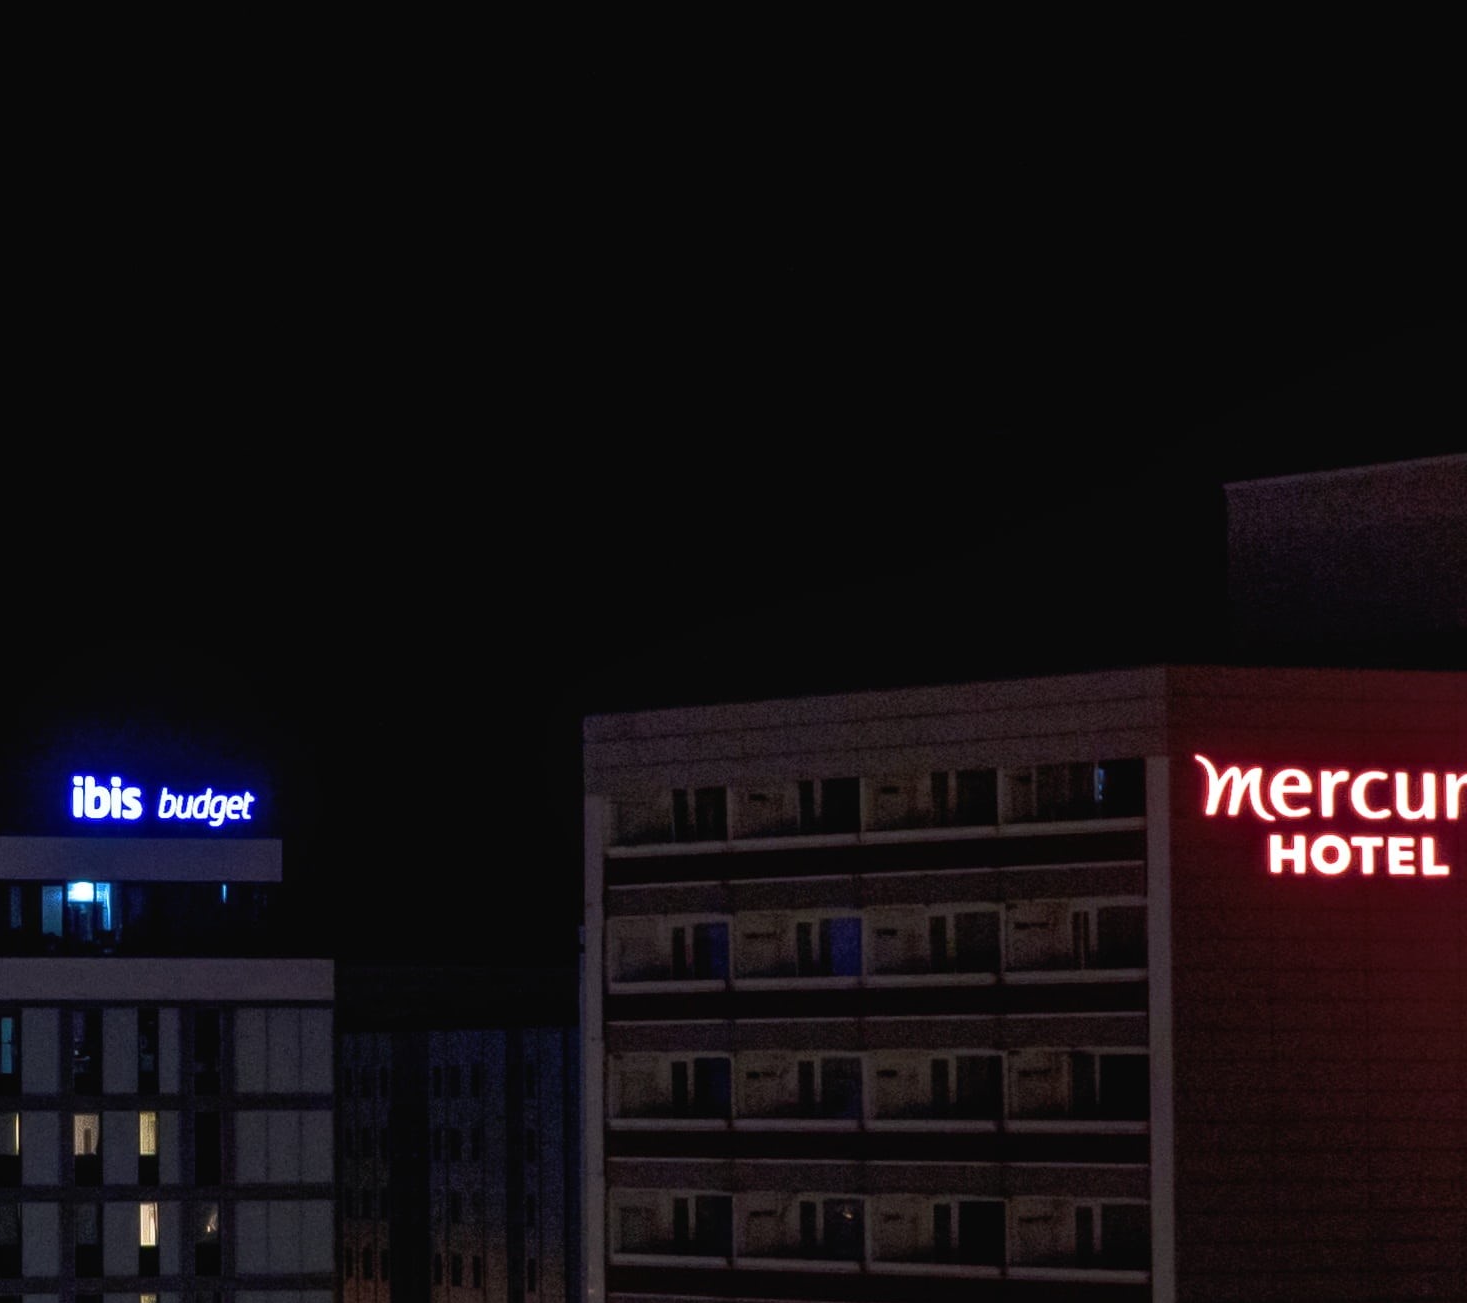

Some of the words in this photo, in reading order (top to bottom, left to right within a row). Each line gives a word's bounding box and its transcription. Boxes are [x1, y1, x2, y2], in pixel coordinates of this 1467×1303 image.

[72, 775, 143, 821] ibis
[157, 787, 255, 827] budget
[1269, 833, 1450, 877] HOTEL
